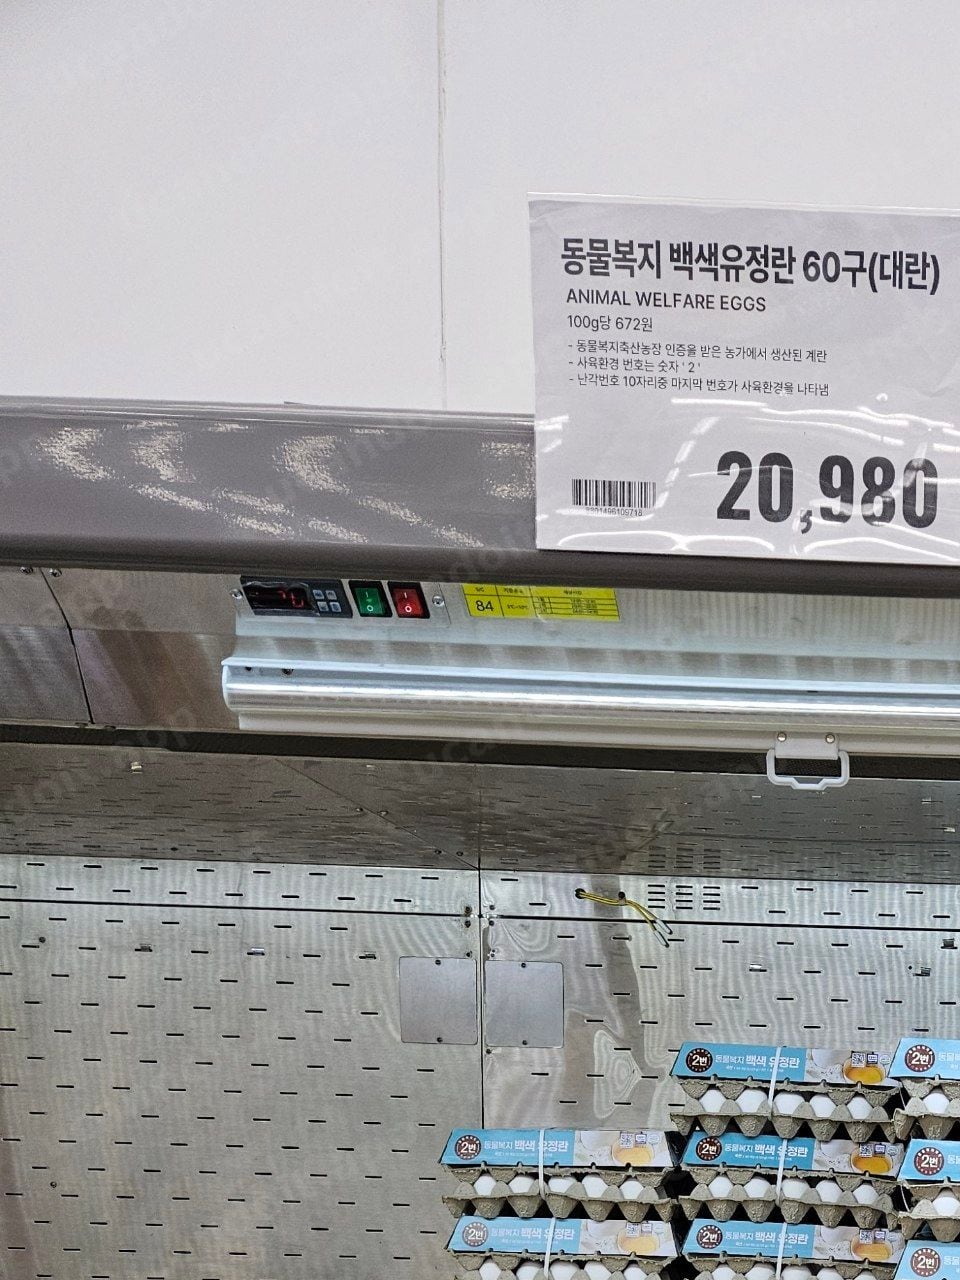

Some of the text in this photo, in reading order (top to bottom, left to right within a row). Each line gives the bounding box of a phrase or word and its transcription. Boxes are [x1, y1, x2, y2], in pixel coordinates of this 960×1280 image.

[560, 237, 940, 295] 동물복지 백색유정란 60구(대란)
[566, 288, 766, 312] ANIMAL WELFARE EGGS
[567, 315, 654, 332] 100g당 672원
[577, 340, 827, 363] 동물복지축산농장 인증을 받은 농가에서 생산된 계란
[577, 358, 619, 370] 사육환경
[623, 360, 654, 372] 번호는
[658, 360, 679, 372] 숫자
[577, 375, 829, 396] 난각번호 10자리중 마지막 번호가 사육환경을 나타냄
[716, 450, 938, 534] 20,980
[476, 599, 495, 612] 84
[692, 1054, 708, 1067] 2번
[912, 1052, 929, 1065] 2번
[460, 1141, 477, 1153] 2번
